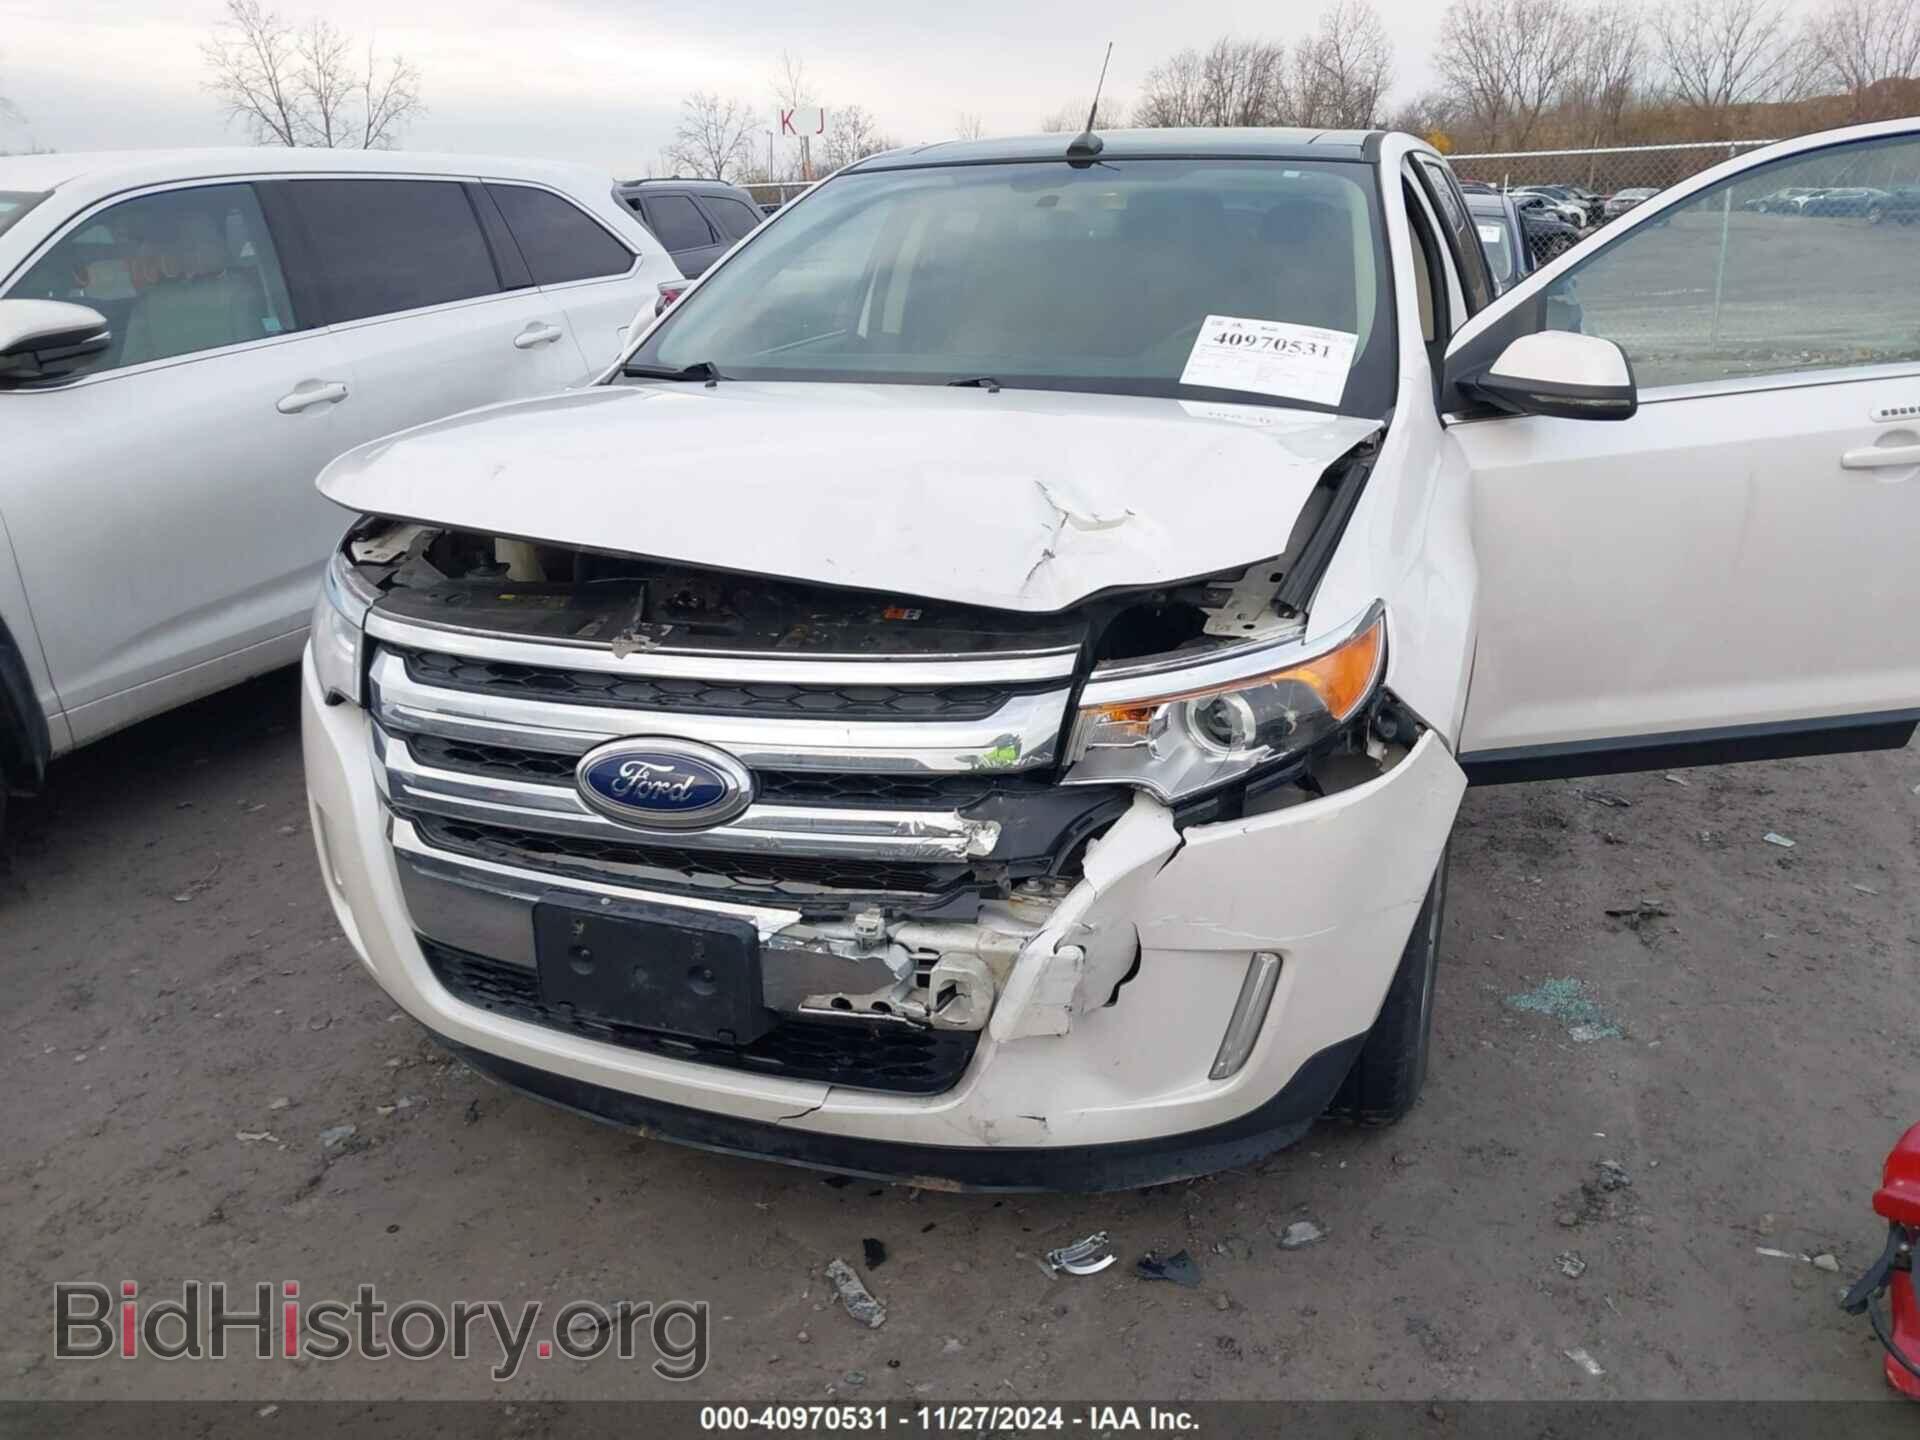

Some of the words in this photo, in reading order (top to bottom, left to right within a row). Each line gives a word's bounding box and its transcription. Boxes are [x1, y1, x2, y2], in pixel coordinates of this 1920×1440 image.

[780, 109, 797, 135] K
[816, 108, 824, 134] J
[1213, 331, 1331, 358] 40970531
[611, 760, 695, 801] Ford
